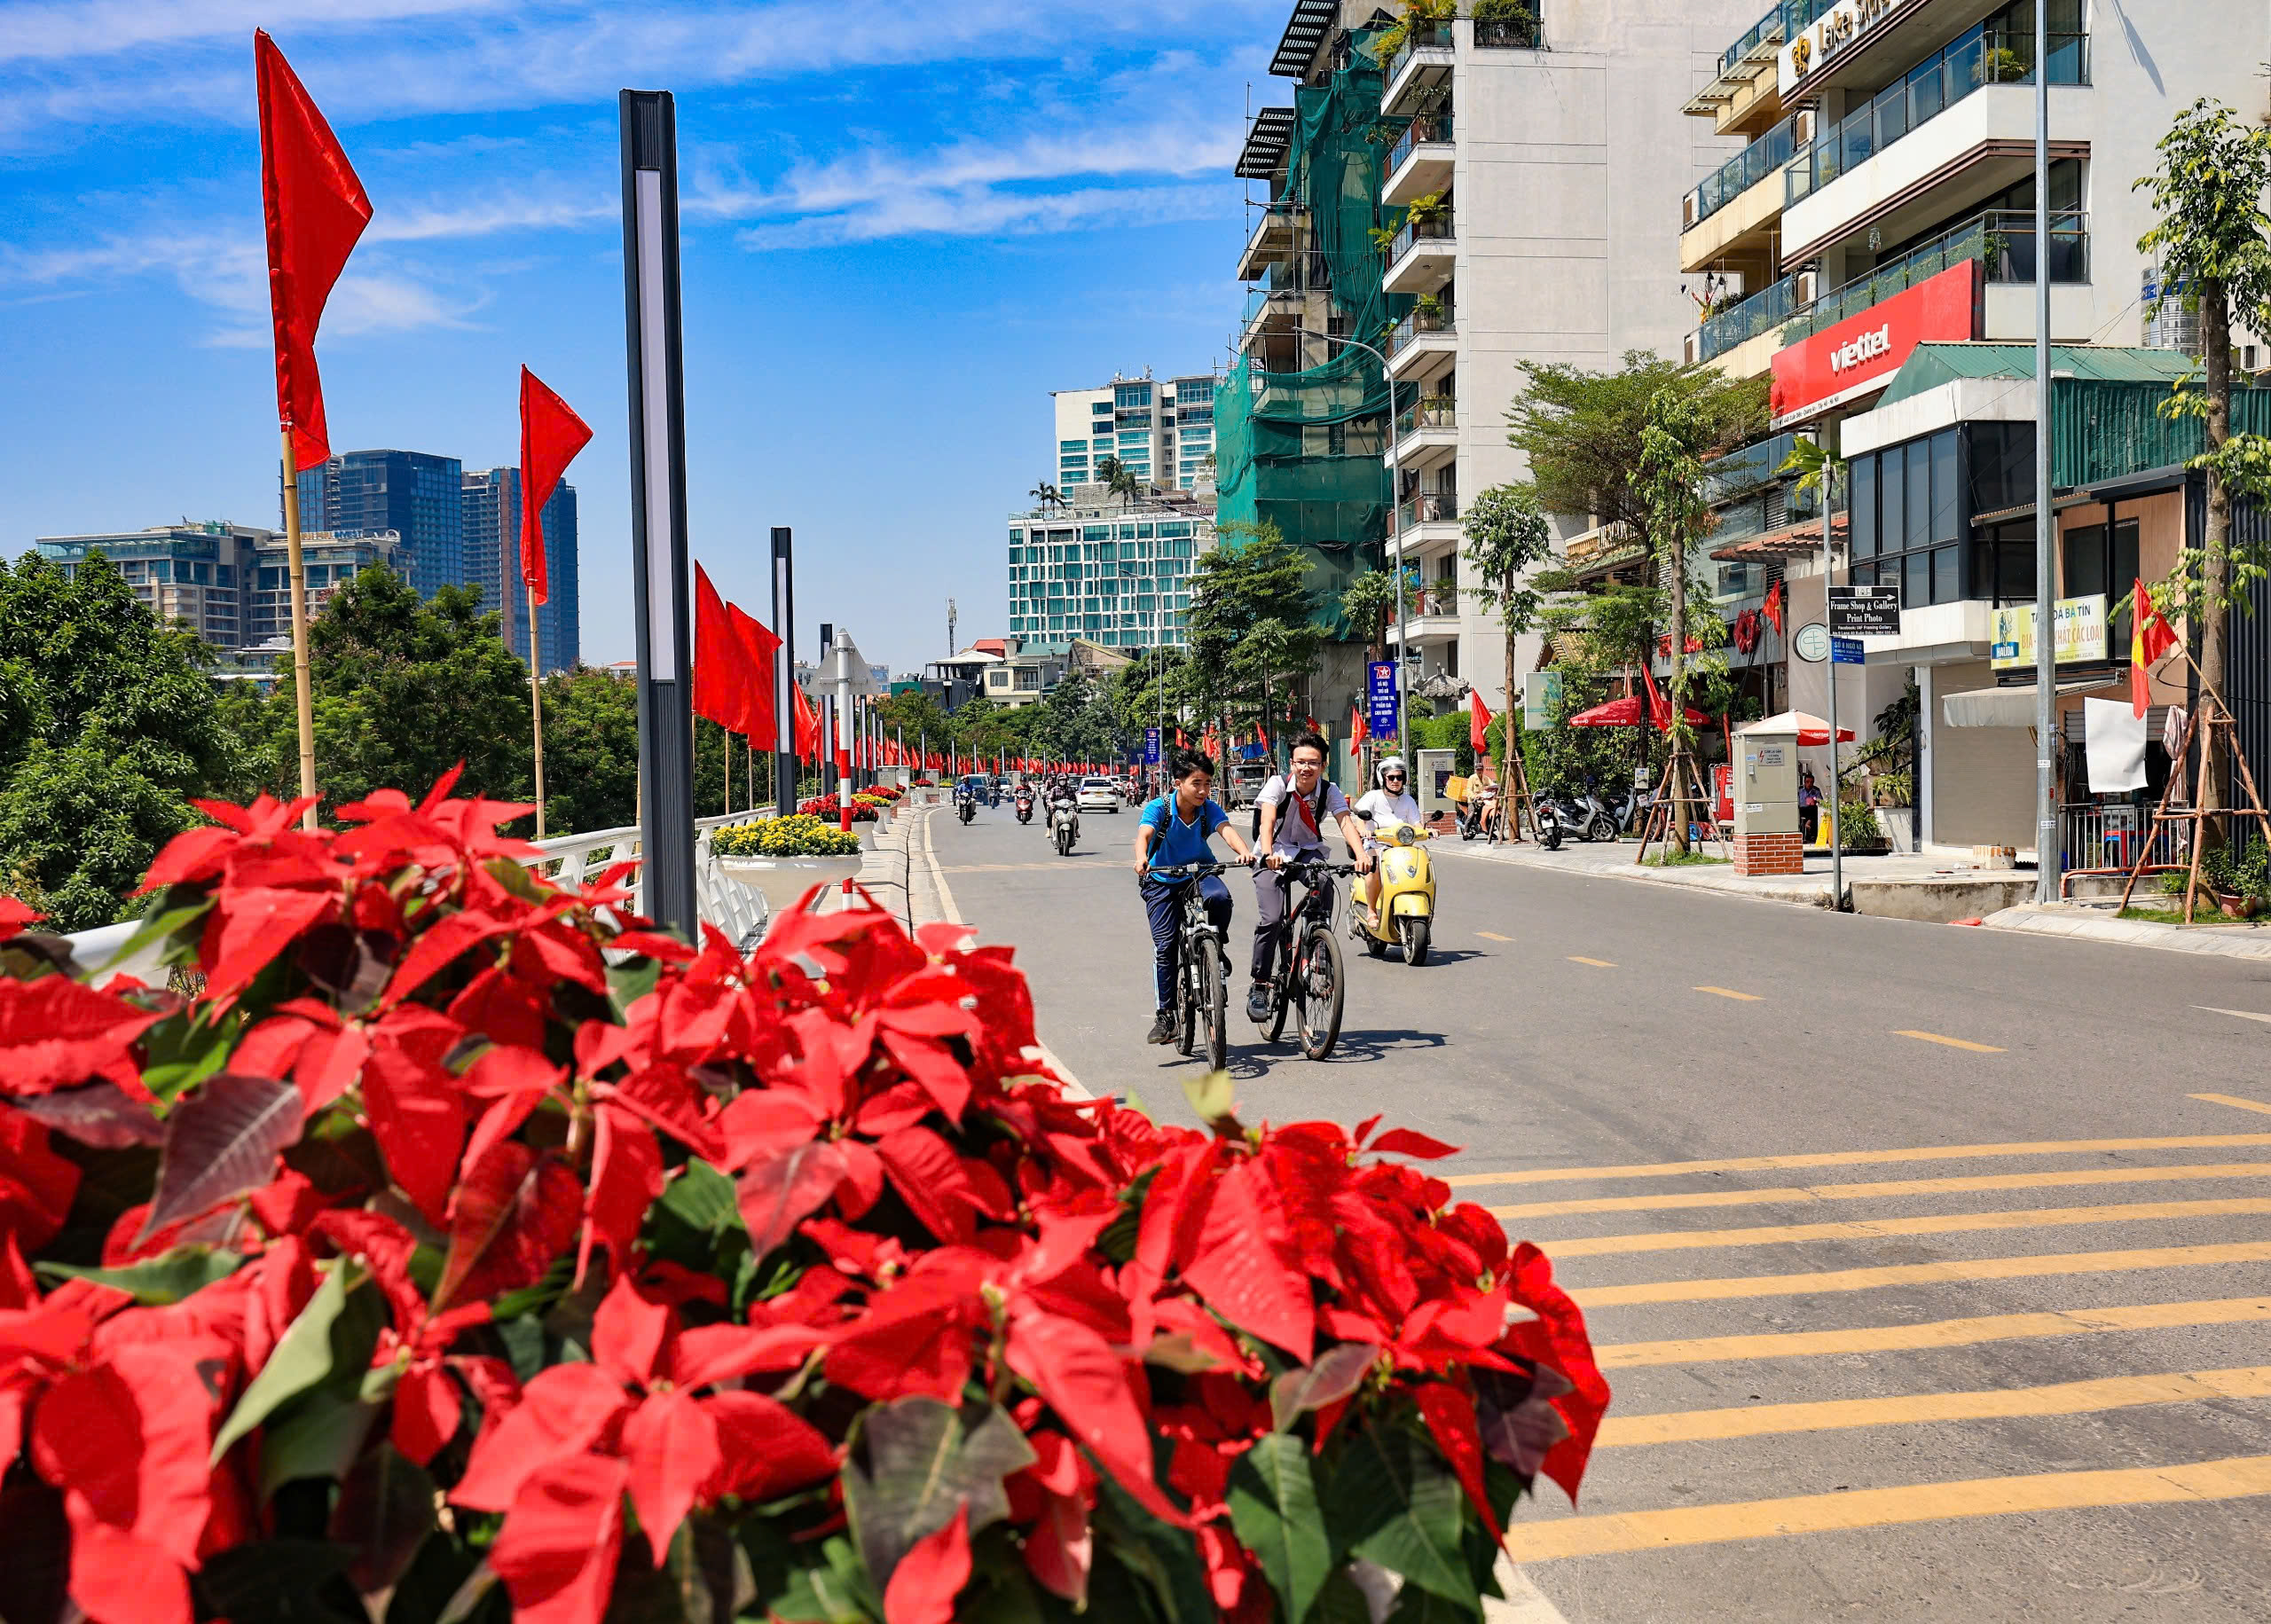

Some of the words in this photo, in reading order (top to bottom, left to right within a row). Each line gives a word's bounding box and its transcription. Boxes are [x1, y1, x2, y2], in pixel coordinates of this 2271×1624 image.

[1818, 11, 1853, 56] Lake
[1830, 323, 1891, 373] viettel
[1830, 600, 1850, 610] Frame
[1850, 600, 1866, 613] Shop
[1866, 601, 1873, 611] &
[1874, 600, 1898, 613] Gallery
[2078, 603, 2091, 617] TÍN
[1846, 613, 1863, 623] Print
[1864, 613, 1882, 623] Photo
[2022, 633, 2033, 649] BIA
[2072, 624, 2085, 644] CÁC
[2086, 624, 2102, 646] LOẠI
